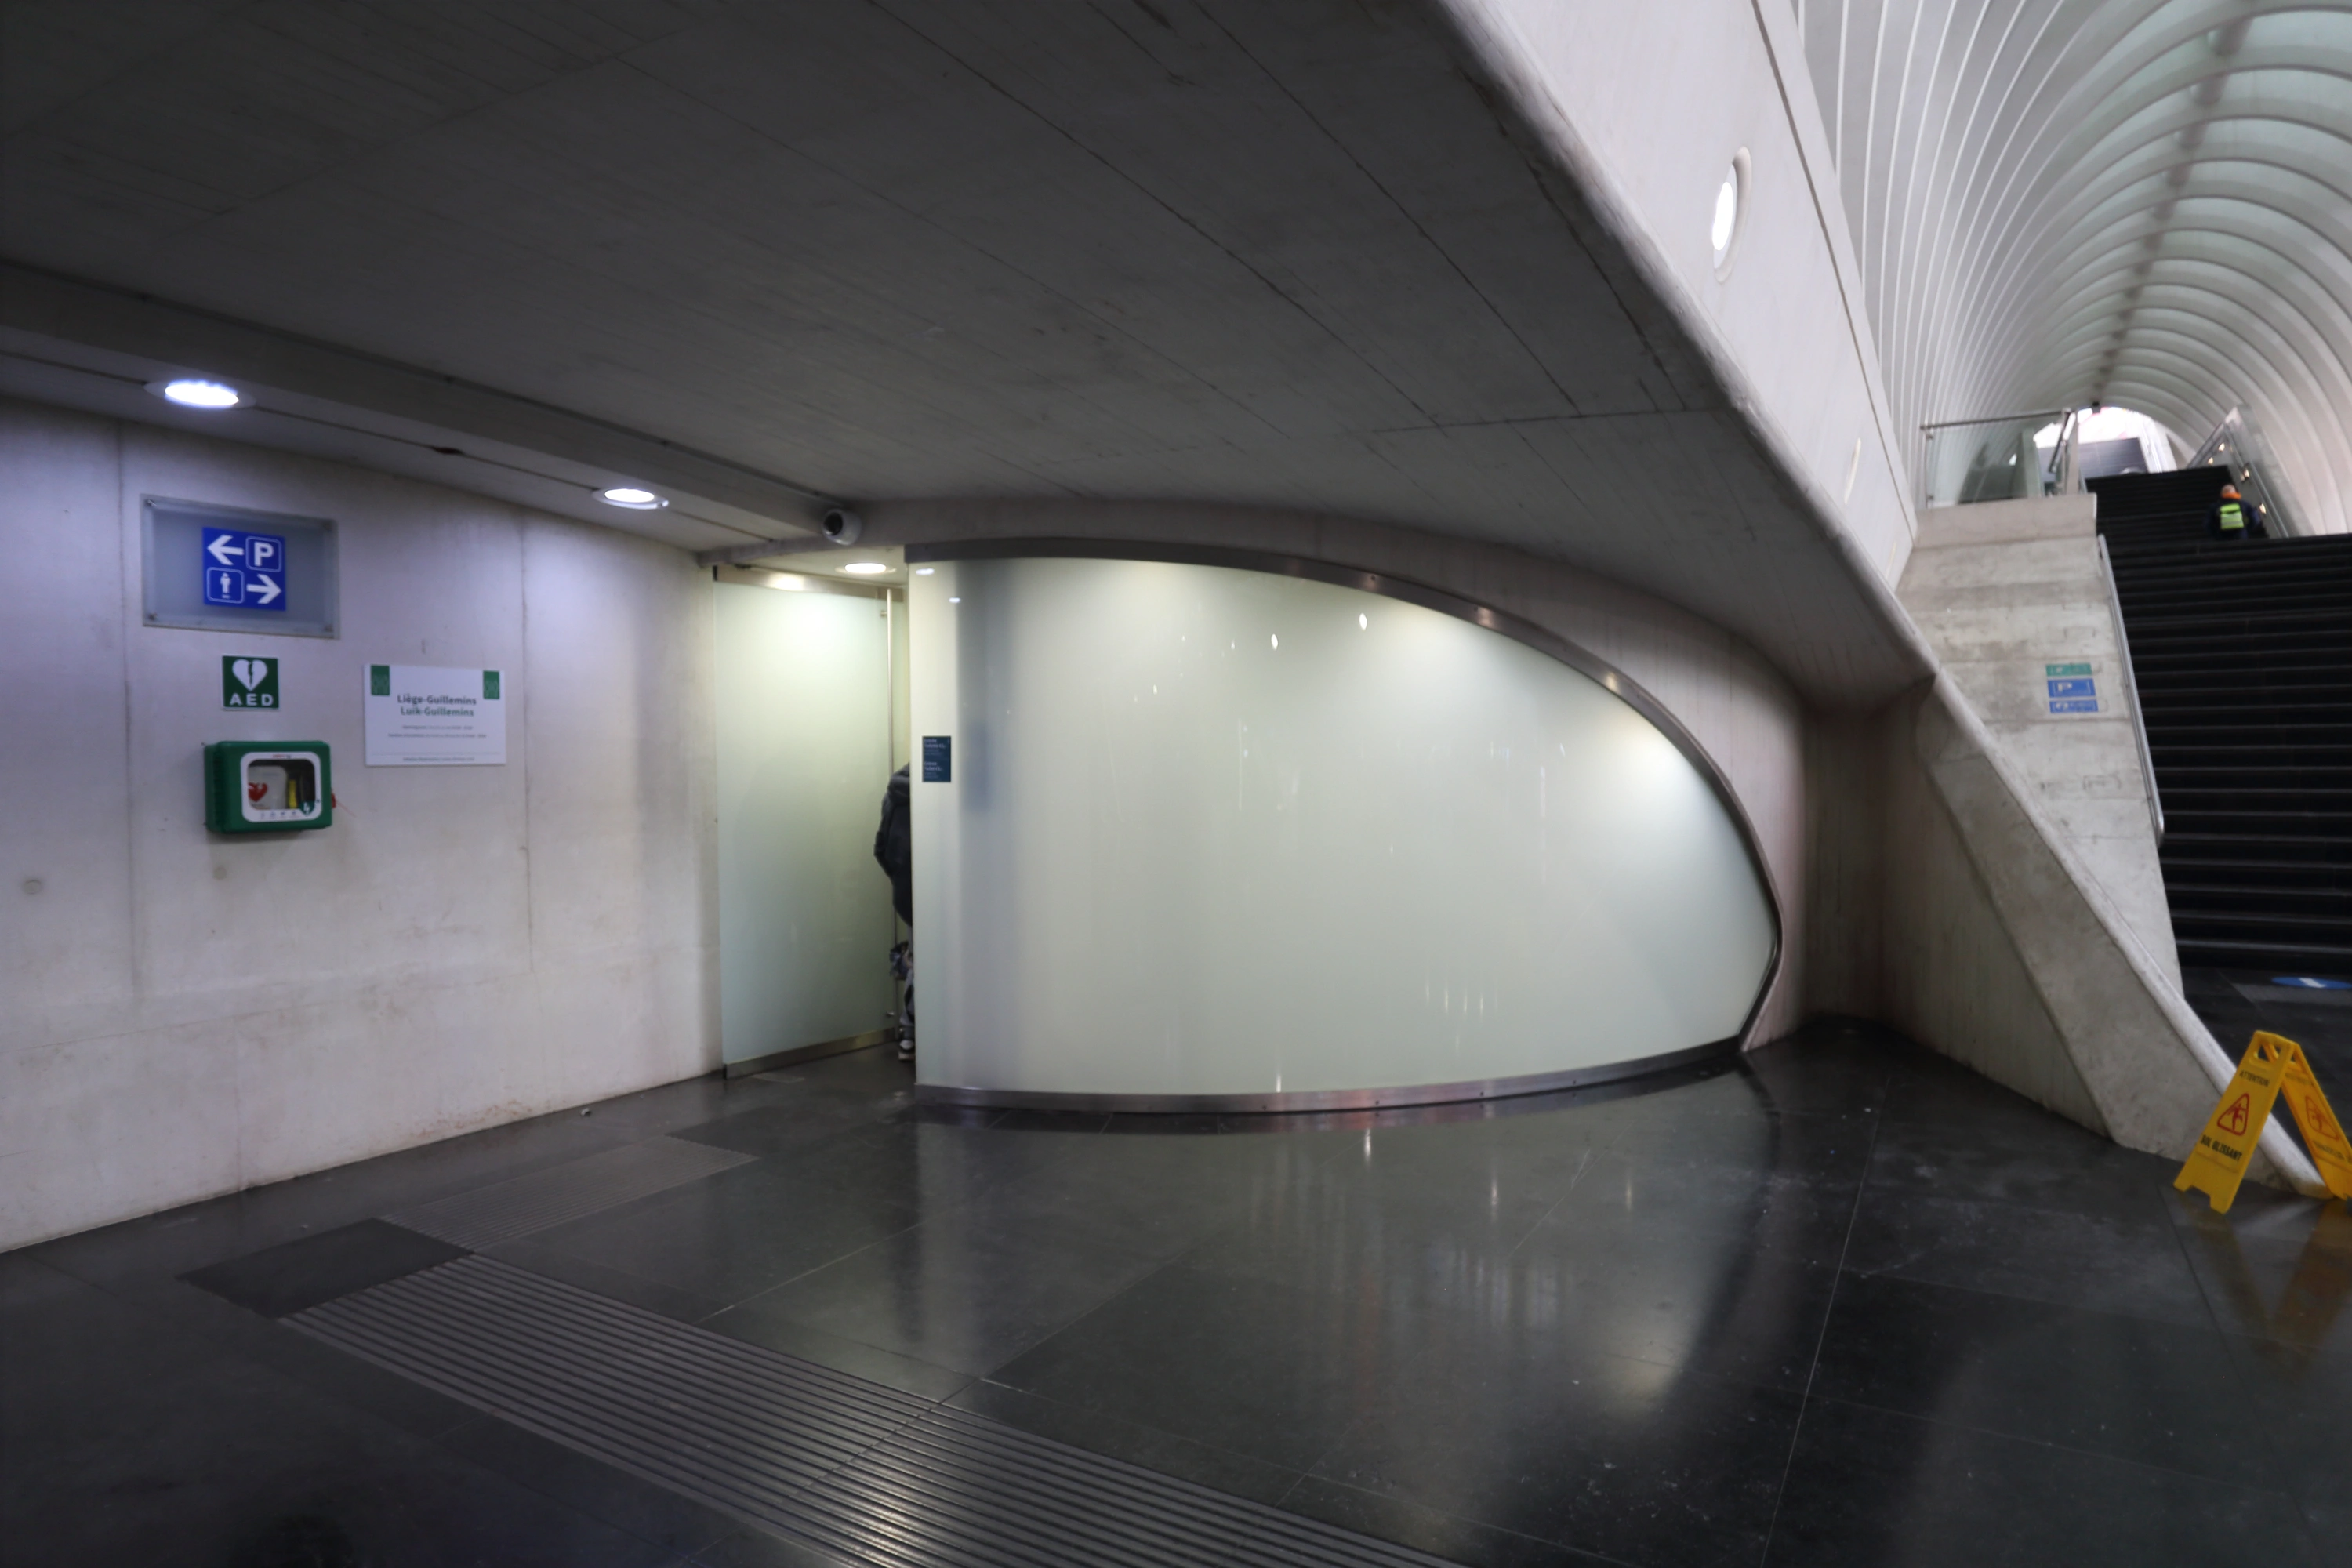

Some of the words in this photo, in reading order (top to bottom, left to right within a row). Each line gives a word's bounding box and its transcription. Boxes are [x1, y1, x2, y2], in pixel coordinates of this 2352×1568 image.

[253, 541, 274, 567] P
[230, 692, 274, 706] AED
[397, 693, 477, 706] Liège-Guillemins
[401, 706, 474, 717] Luik-Guillemins
[2239, 1069, 2270, 1087] ATTENTION
